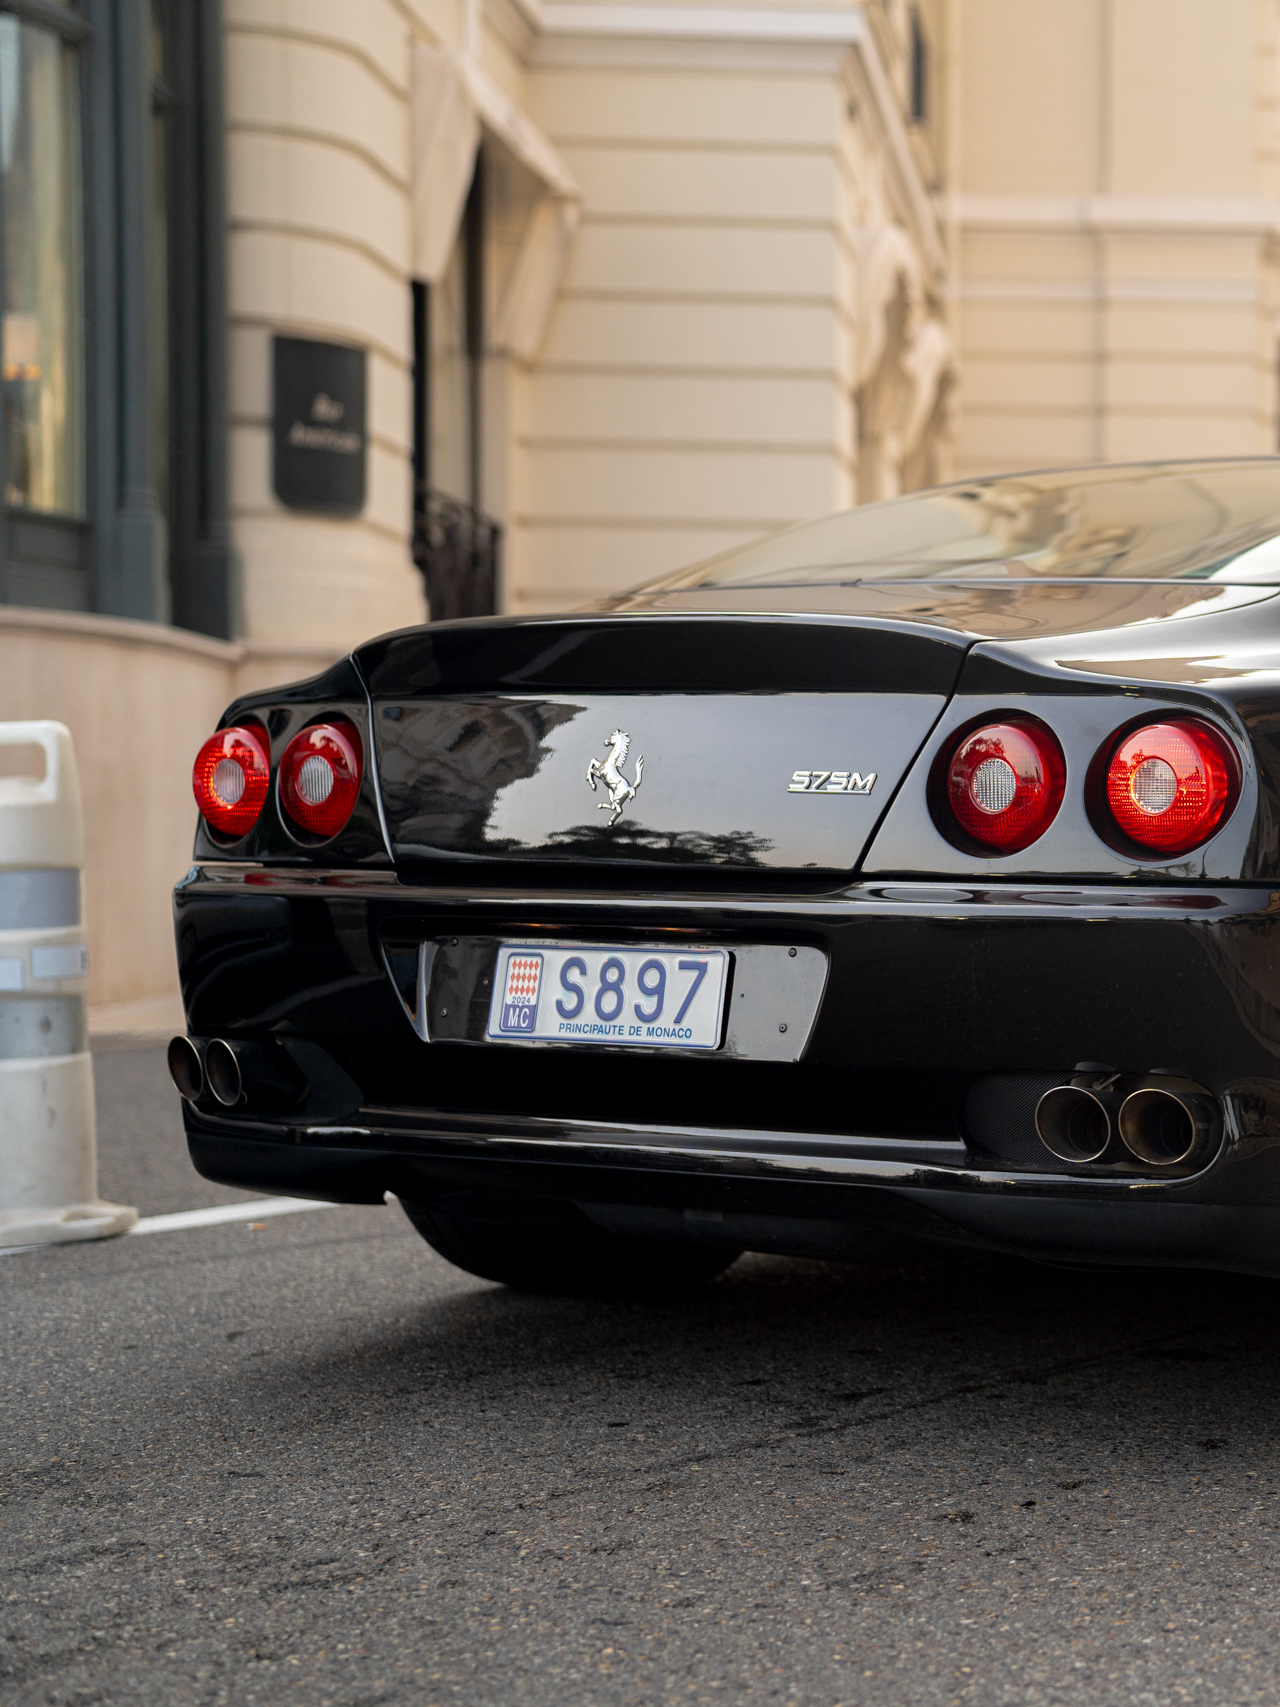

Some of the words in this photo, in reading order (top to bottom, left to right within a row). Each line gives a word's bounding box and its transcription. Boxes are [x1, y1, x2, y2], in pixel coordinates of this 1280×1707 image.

[788, 771, 878, 793] 575M
[555, 955, 709, 1024] S897
[511, 996, 531, 1005] 2024
[507, 1007, 530, 1028] MC
[558, 1022, 625, 1036] PRINCIPAUTE
[628, 1026, 643, 1037] DE
[646, 1026, 693, 1039] MONACO
